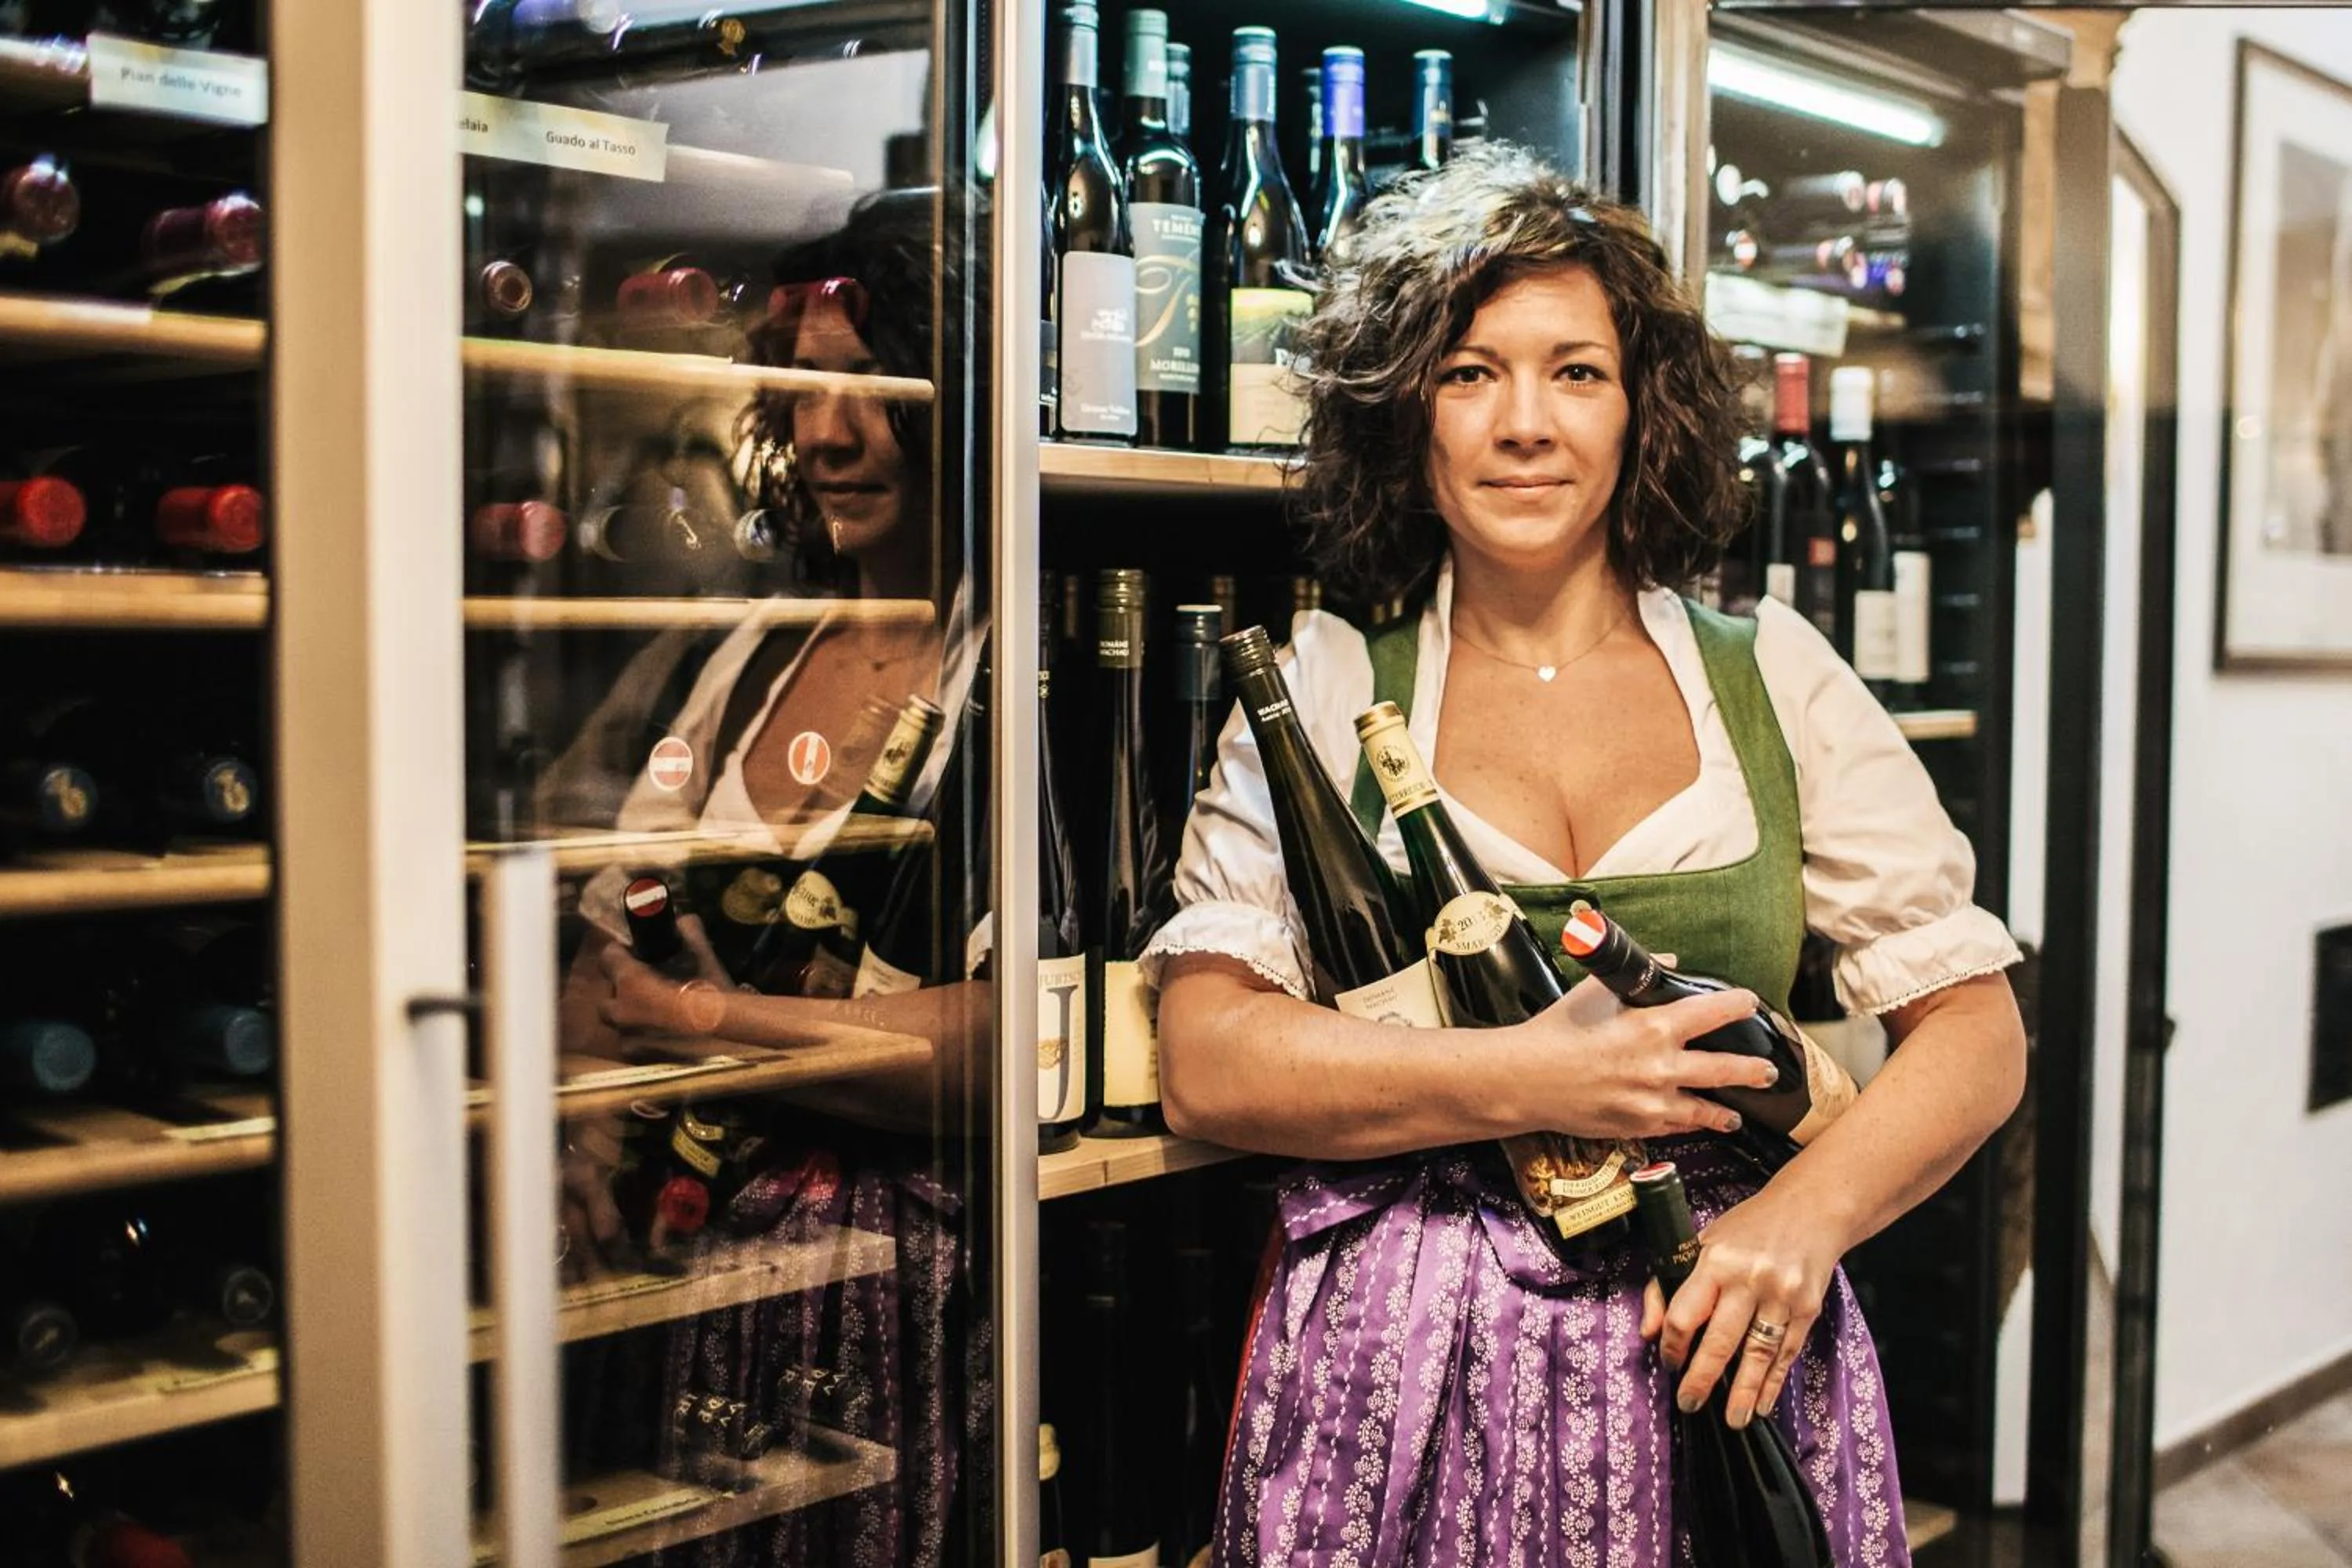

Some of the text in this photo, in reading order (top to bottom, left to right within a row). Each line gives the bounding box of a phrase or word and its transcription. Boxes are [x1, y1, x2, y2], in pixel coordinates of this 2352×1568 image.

[158, 69, 195, 91] delle
[199, 81, 243, 99] Vigne
[546, 129, 637, 156] Guado al Tasso
[1456, 925, 1504, 951] SMARGD
